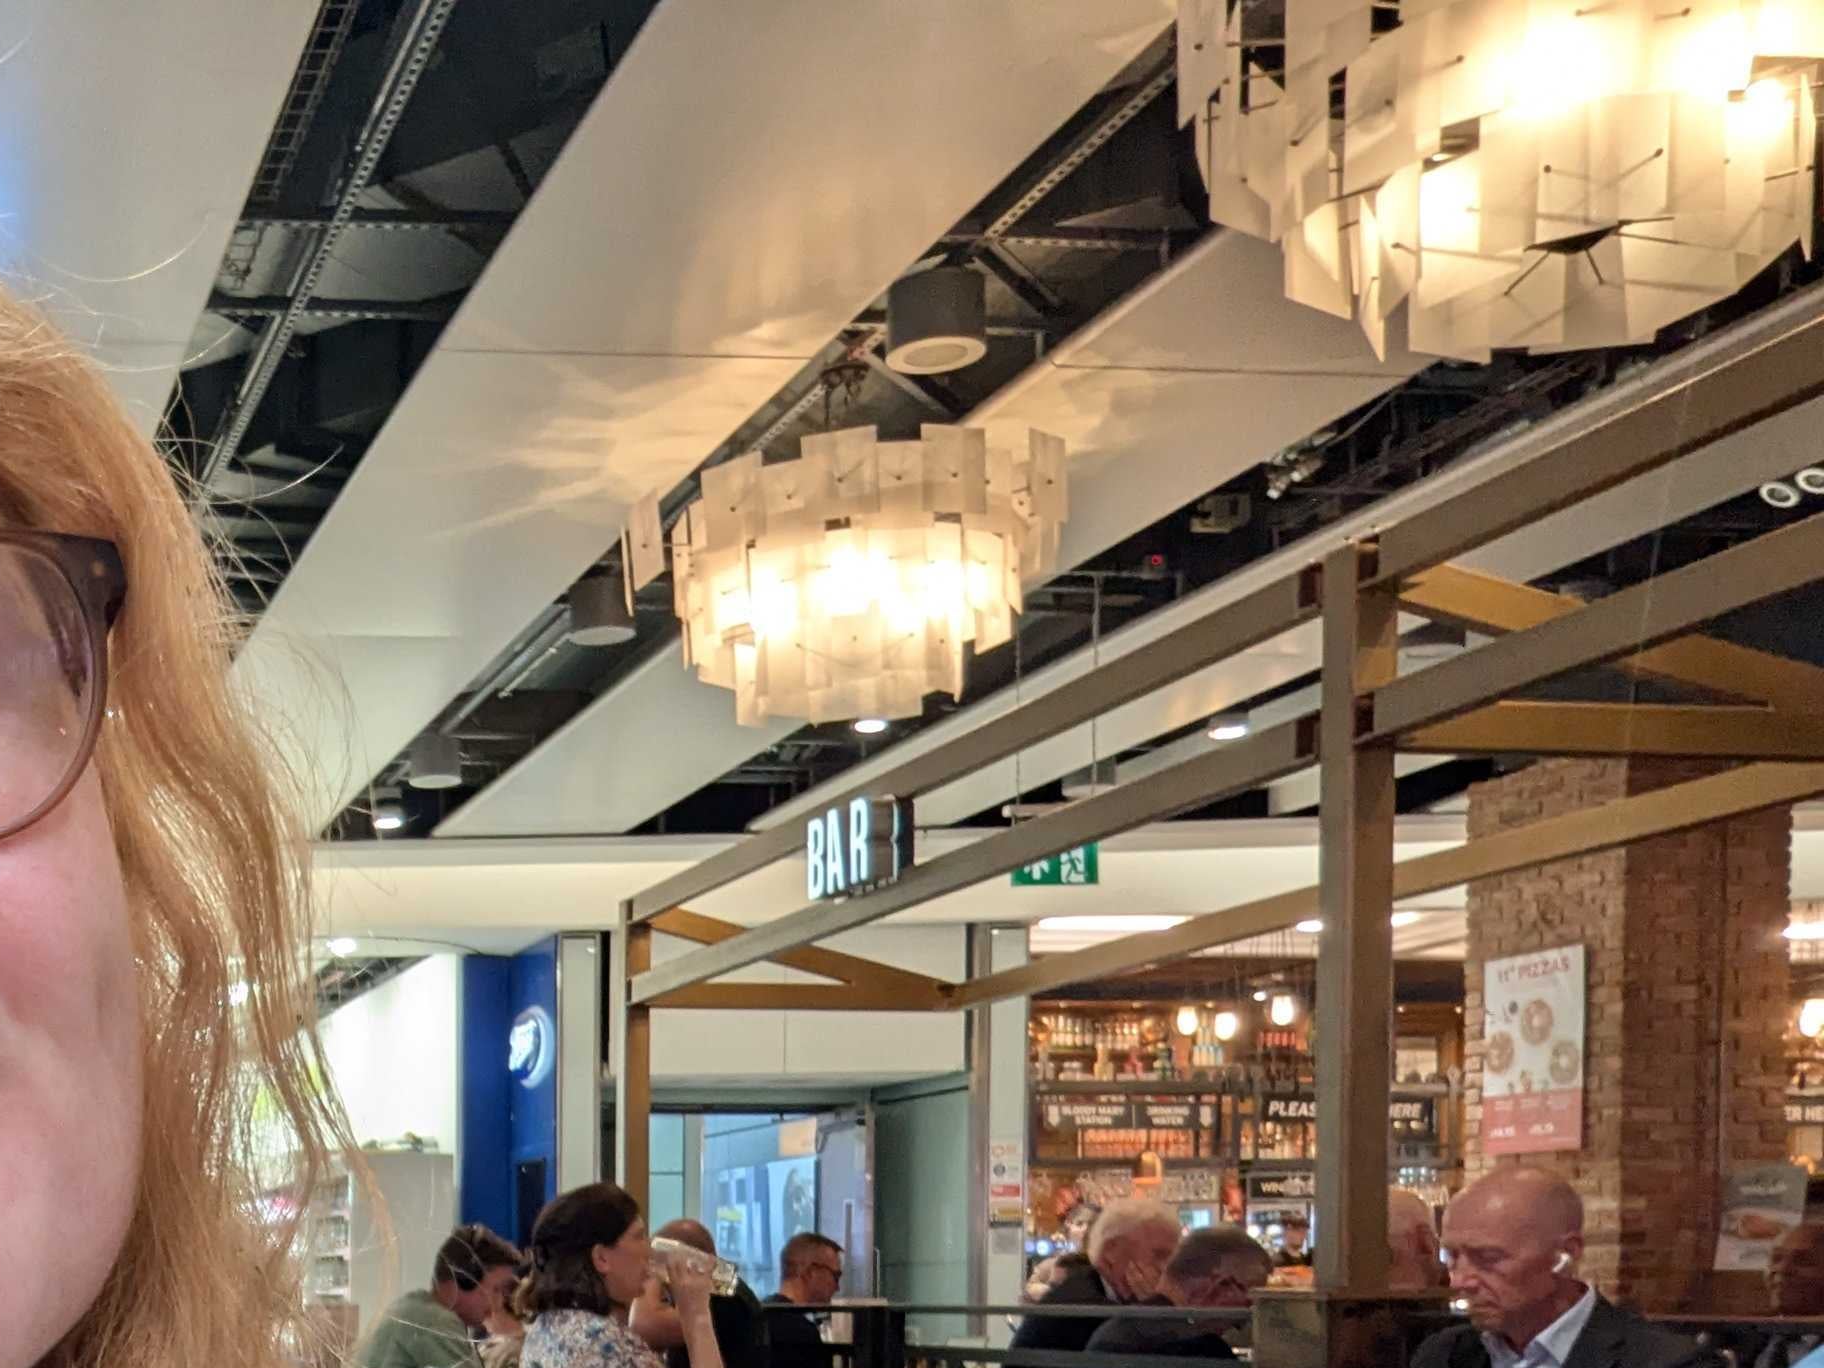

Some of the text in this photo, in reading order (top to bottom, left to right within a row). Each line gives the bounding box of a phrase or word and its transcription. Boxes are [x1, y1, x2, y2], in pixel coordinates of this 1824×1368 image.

[807, 797, 869, 901] BAR
[1098, 1105, 1125, 1115] MARY
[1075, 1116, 1112, 1125] STATION
[1151, 1116, 1184, 1126] WATER
